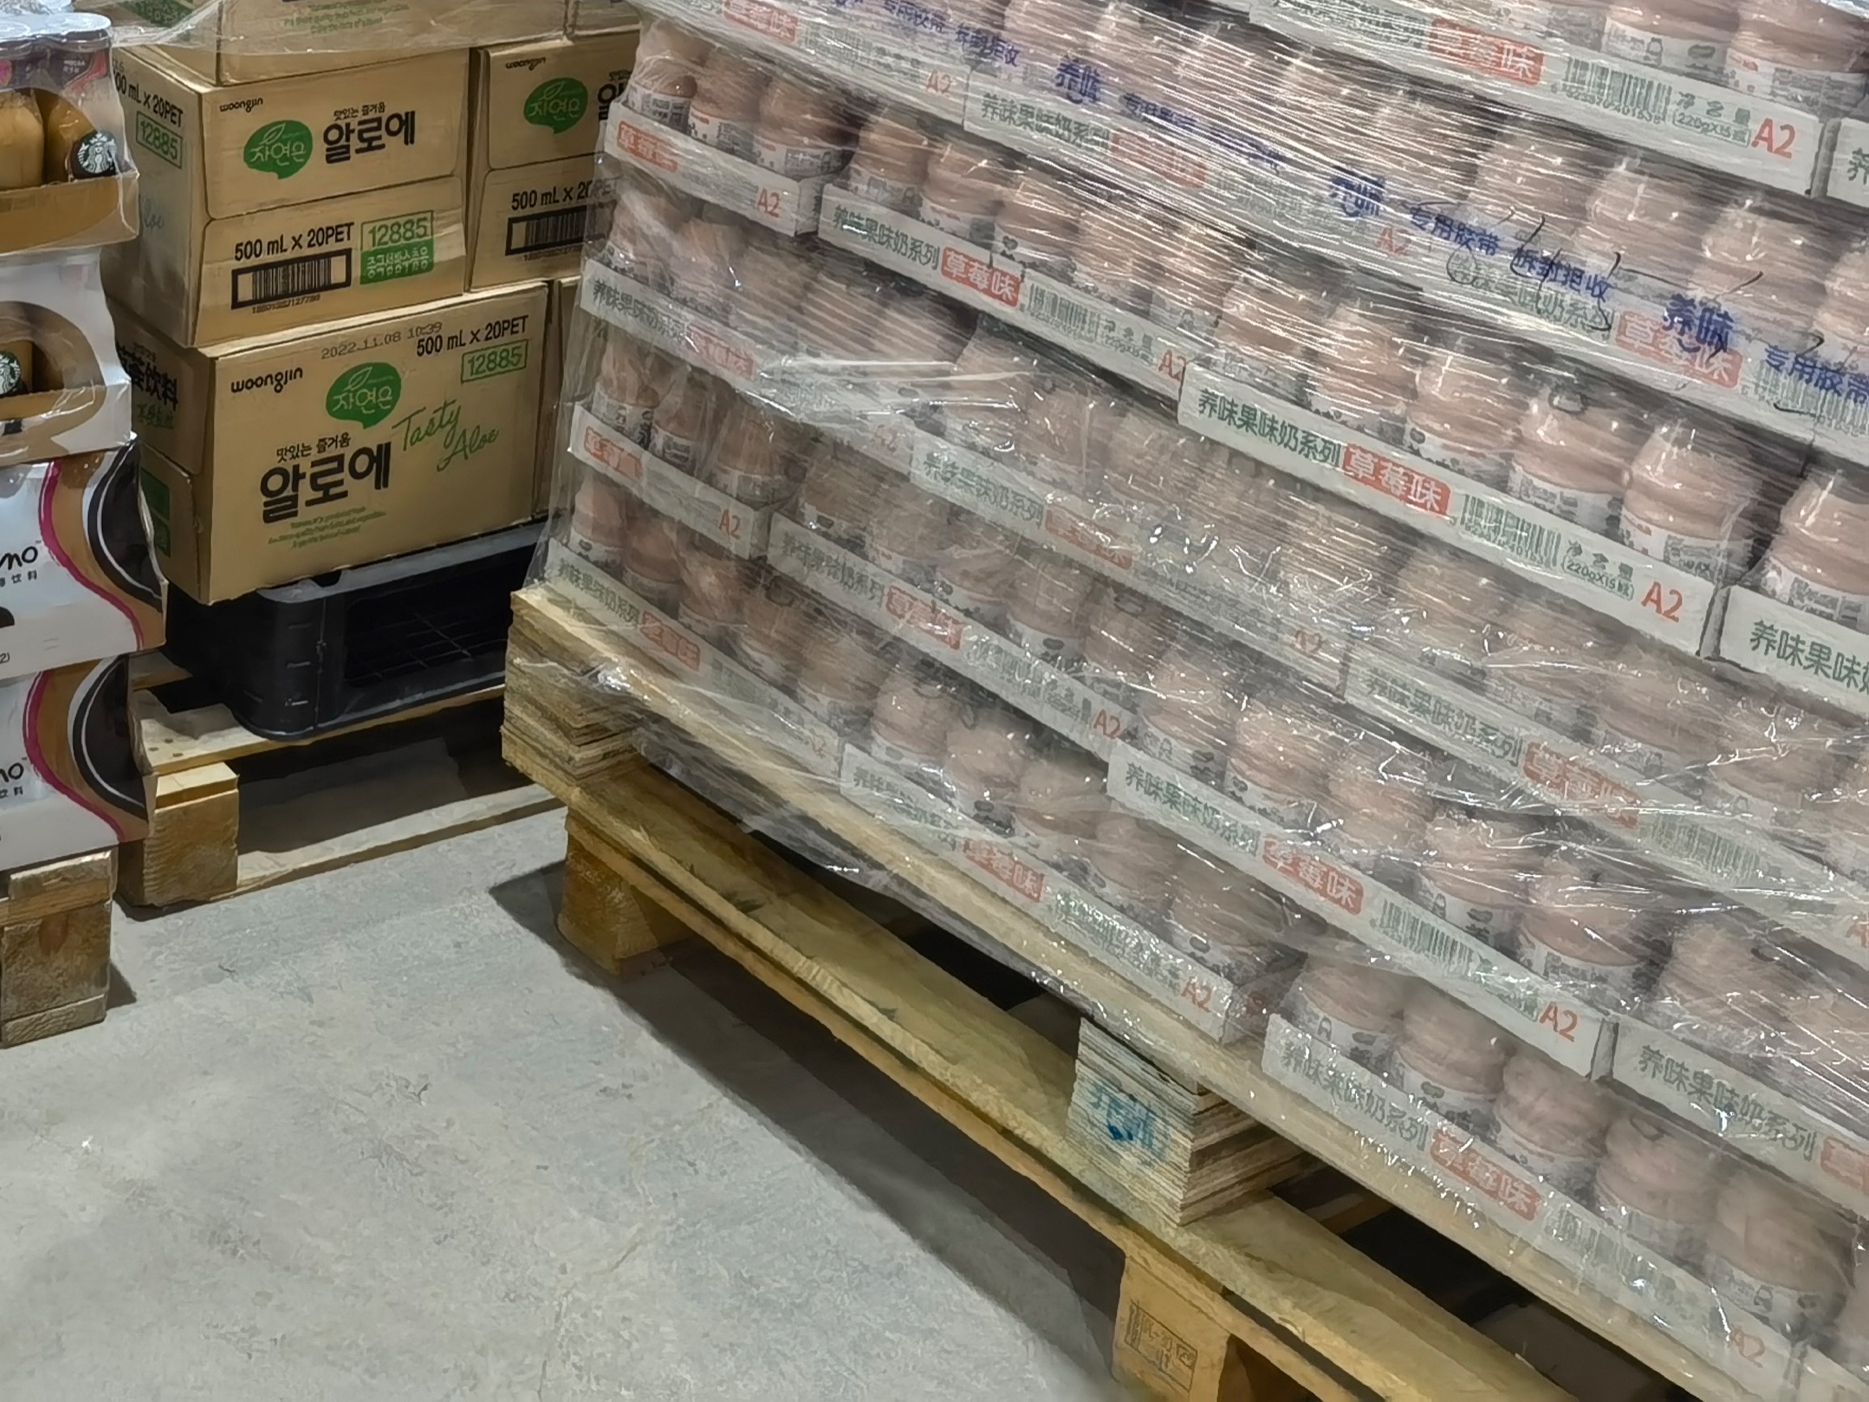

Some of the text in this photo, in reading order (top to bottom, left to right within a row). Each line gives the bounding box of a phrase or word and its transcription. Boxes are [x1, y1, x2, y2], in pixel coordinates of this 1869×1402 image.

[140, 122, 179, 161] 12885
[323, 110, 416, 164] 알로에
[1751, 117, 1797, 159] A2
[511, 190, 538, 211] 500
[540, 186, 560, 206] mL
[757, 186, 781, 219] A2
[234, 238, 262, 261] 500
[266, 232, 288, 254] mL
[307, 221, 355, 249] 20PET
[368, 216, 428, 248] 12885
[833, 205, 941, 270] 养味果味奶系列
[1410, 207, 1500, 257] 专用胶带
[944, 250, 1019, 303] 草莓味
[416, 335, 443, 358] 500
[447, 329, 466, 349] mL
[484, 315, 529, 342] 20PET
[231, 367, 304, 394] woongjin
[467, 346, 523, 377] 12885
[331, 385, 394, 414] 자연은
[391, 398, 461, 452] Tasty
[1198, 388, 1342, 468] 养味果味奶系列
[276, 443, 313, 463] 맛있는
[436, 428, 499, 473] Aloe
[260, 441, 392, 524] 알로에
[1345, 451, 1443, 513] 草莓味
[719, 508, 742, 538] A2
[1641, 581, 1684, 623] A2
[1093, 709, 1124, 740] A2
[1182, 981, 1213, 1012] A2
[1540, 1002, 1579, 1043] A2
